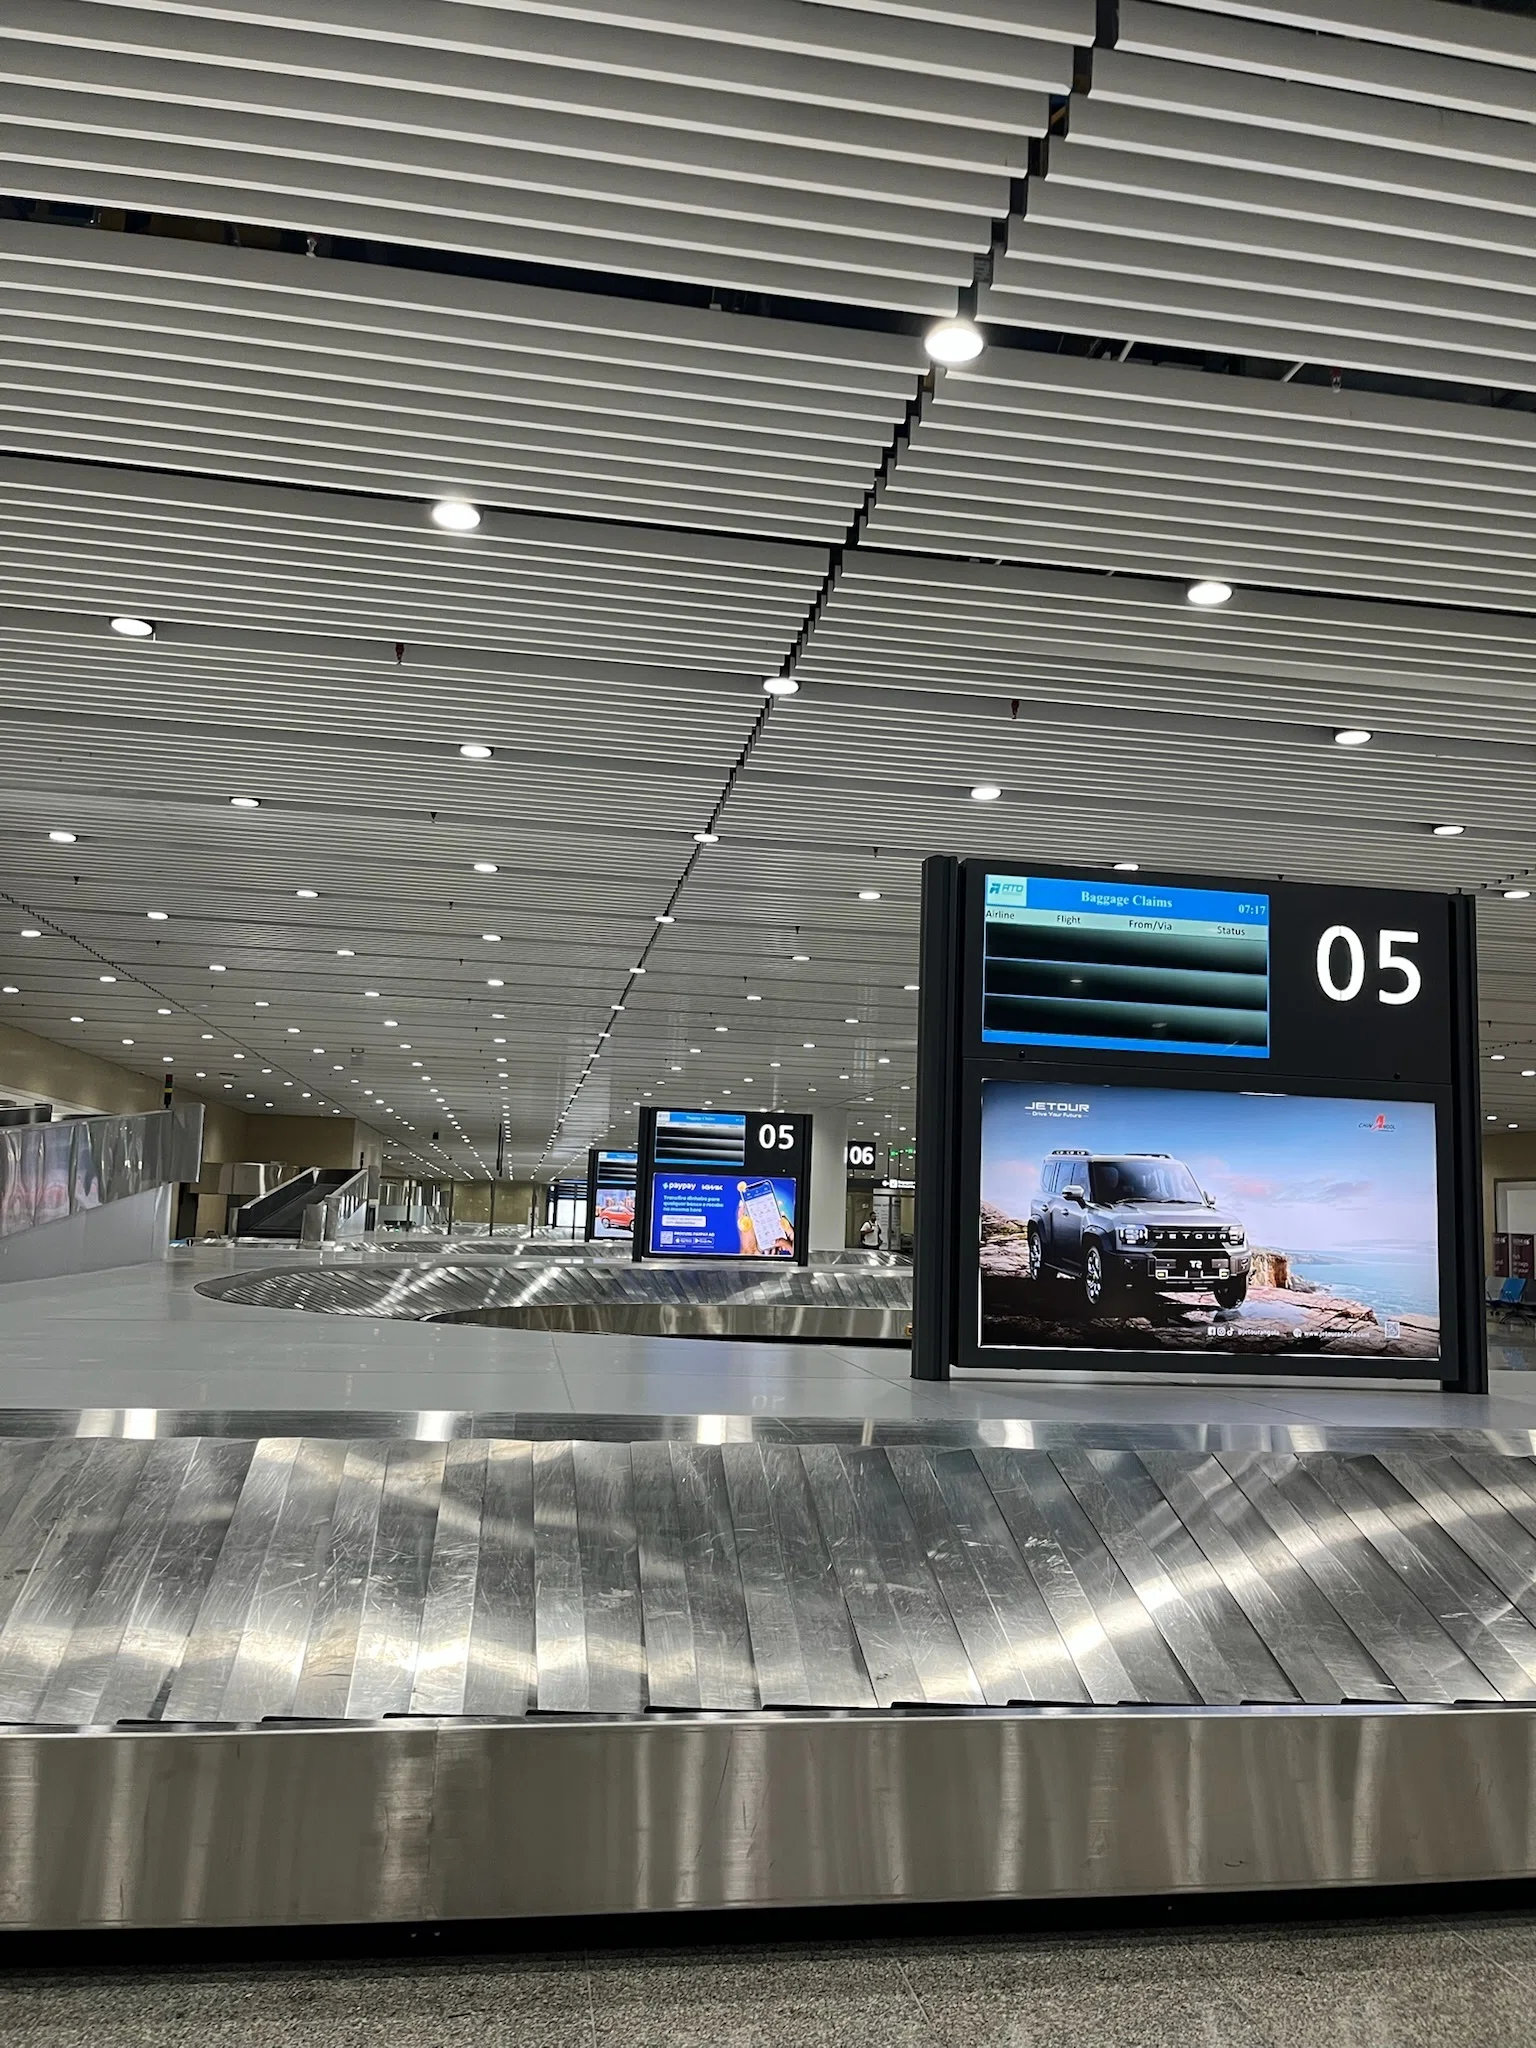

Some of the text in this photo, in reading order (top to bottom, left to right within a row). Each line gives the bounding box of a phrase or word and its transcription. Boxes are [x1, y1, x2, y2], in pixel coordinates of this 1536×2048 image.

[1081, 891, 1173, 908] Baggage Claims
[1238, 903, 1266, 915] 07:17
[986, 910, 1246, 936] Airline Flight From/Via Status
[1317, 925, 1422, 1006] 05
[1024, 1102, 1090, 1112] JETOUR
[758, 1123, 795, 1150] 05
[849, 1145, 875, 1165] 06
[668, 1182, 696, 1191] paypay
